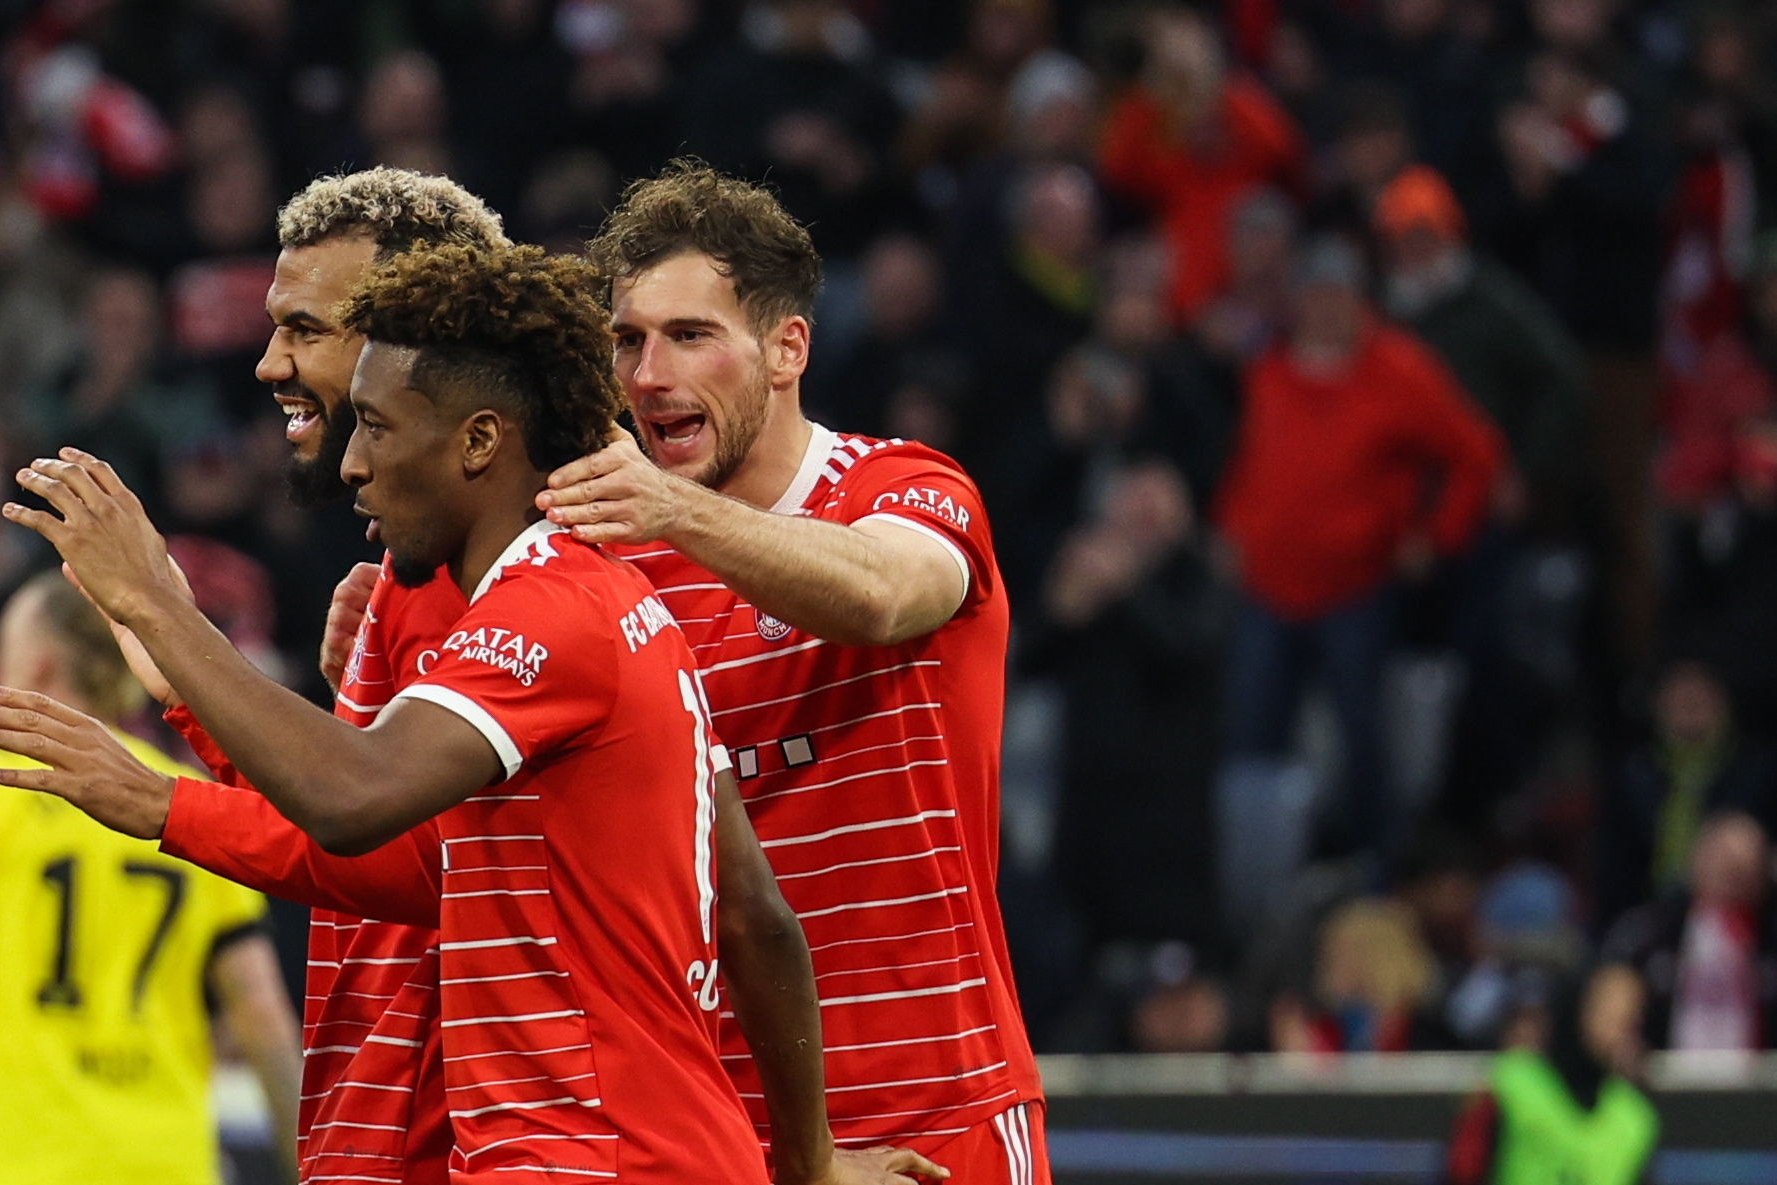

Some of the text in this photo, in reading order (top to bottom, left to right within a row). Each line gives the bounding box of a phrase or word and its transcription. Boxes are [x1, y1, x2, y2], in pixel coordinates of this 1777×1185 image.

[442, 627, 549, 673] QATAR
[619, 610, 648, 653] FC
[458, 645, 536, 687] AIRWAYS
[36, 856, 187, 1016] 17
